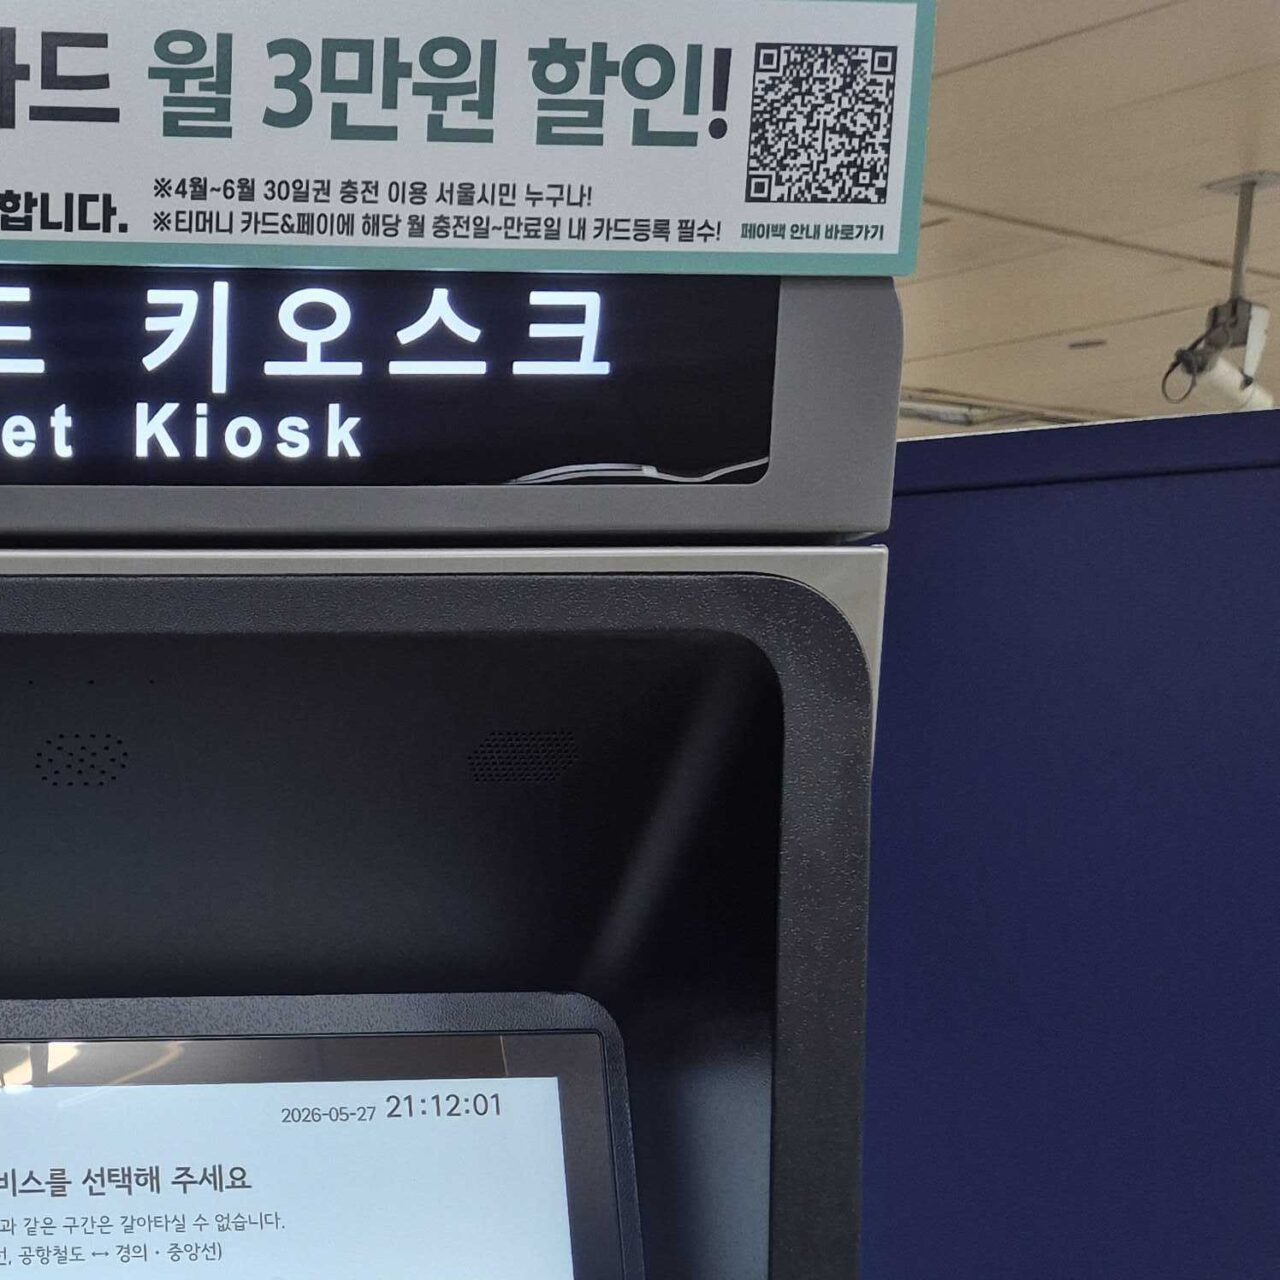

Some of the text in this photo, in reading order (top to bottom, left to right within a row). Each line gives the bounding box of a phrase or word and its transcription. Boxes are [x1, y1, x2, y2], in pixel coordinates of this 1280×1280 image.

[148, 29, 233, 141] 월
[263, 35, 496, 144] 3만원
[528, 37, 733, 147] 할인!
[154, 177, 593, 208] ※4월~6월 30일권 충전 이용 서울시민 누구나!
[153, 210, 722, 243] ※티머니 카드&페이에 해당 월 충전일~만료일 내 카드등록 필수!
[741, 223, 884, 241] 페이백 안내 바로가기
[142, 281, 612, 392] 키오스크
[135, 401, 363, 460] Kiosk
[281, 1093, 503, 1125] 2026-05-27 21:12:01
[81, 1165, 161, 1197] 선택해
[171, 1163, 252, 1194] 주세요
[24, 1216, 57, 1236] 같은
[62, 1215, 114, 1235] 구간은
[120, 1214, 186, 1234] 갈아타실
[192, 1213, 209, 1232] 수
[214, 1212, 286, 1233] 없습니다.
[18, 1245, 86, 1266] 공항철도
[115, 1243, 148, 1263] 경의
[167, 1241, 223, 1262] 중앙선)
